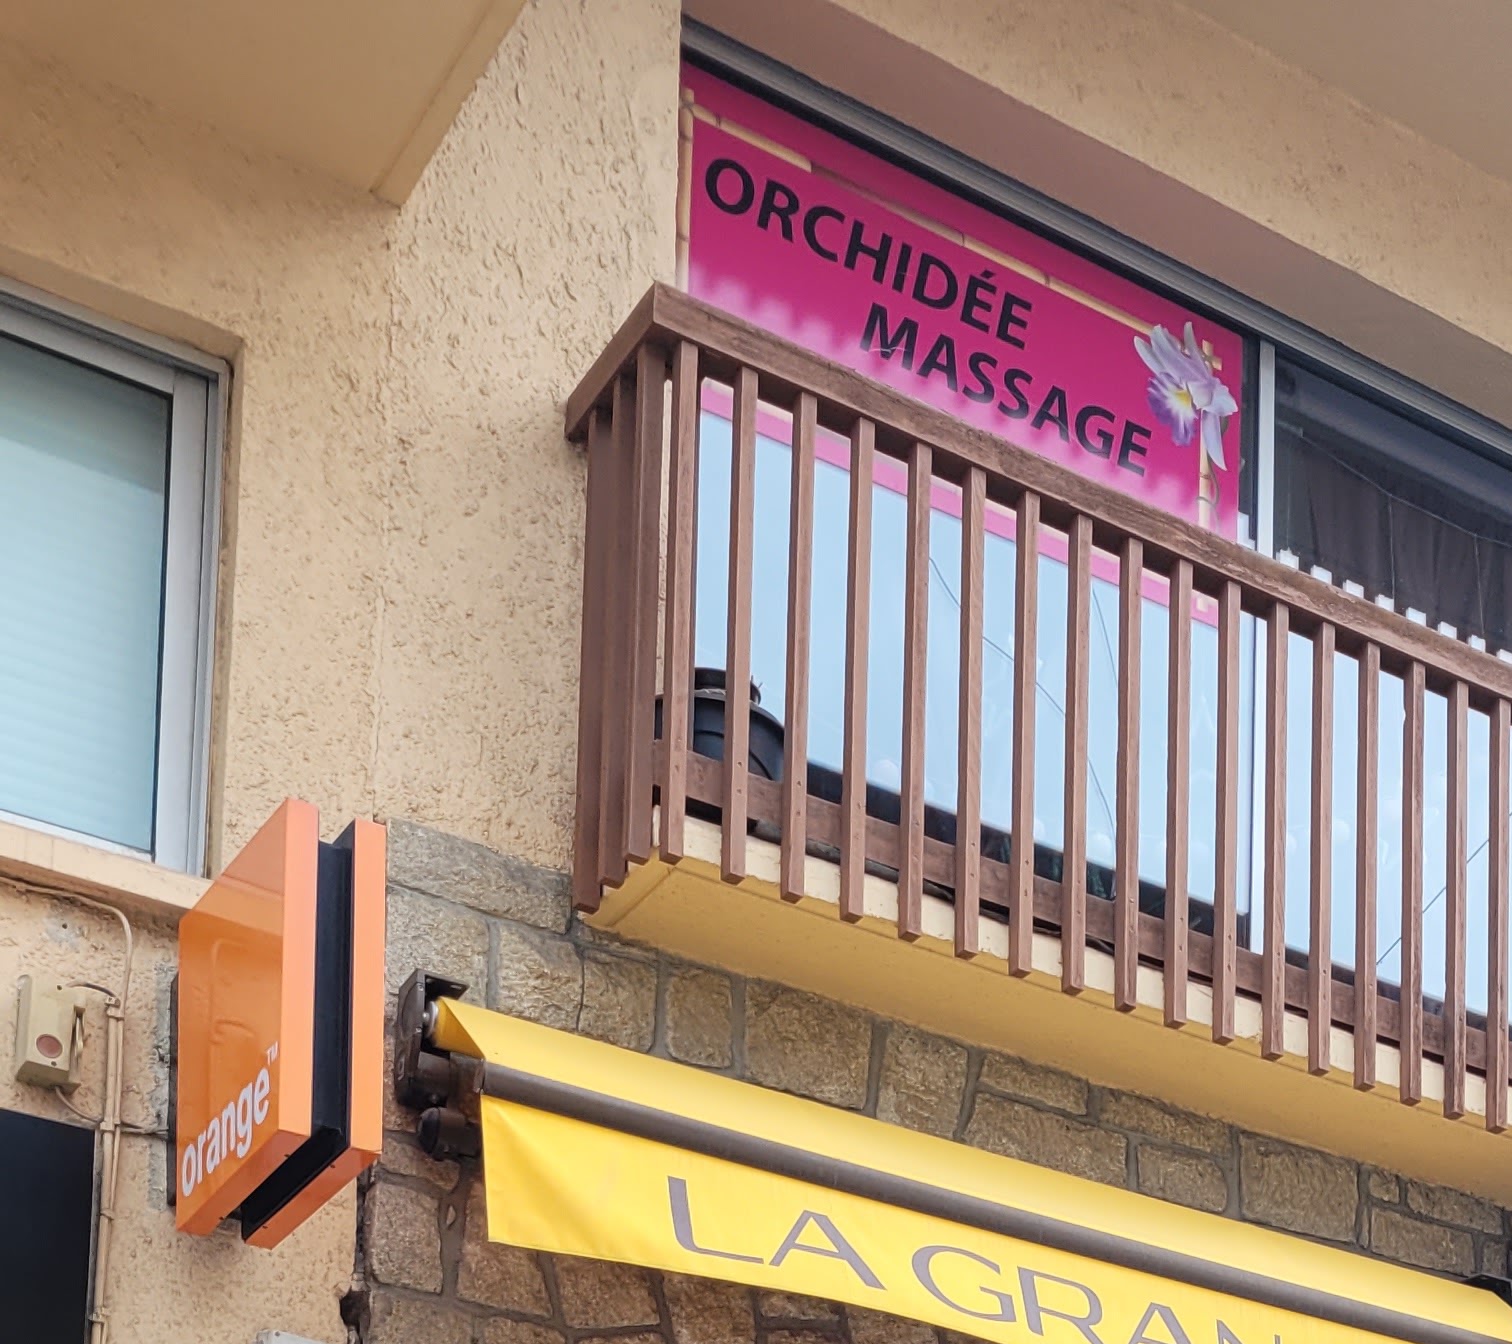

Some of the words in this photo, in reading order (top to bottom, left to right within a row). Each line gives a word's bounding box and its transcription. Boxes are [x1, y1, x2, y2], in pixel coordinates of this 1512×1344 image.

[705, 159, 1032, 349] ORCHIDÉE
[860, 303, 1152, 477] MASSAGE
[182, 1068, 270, 1197] orange
[667, 1176, 886, 1290] LA
